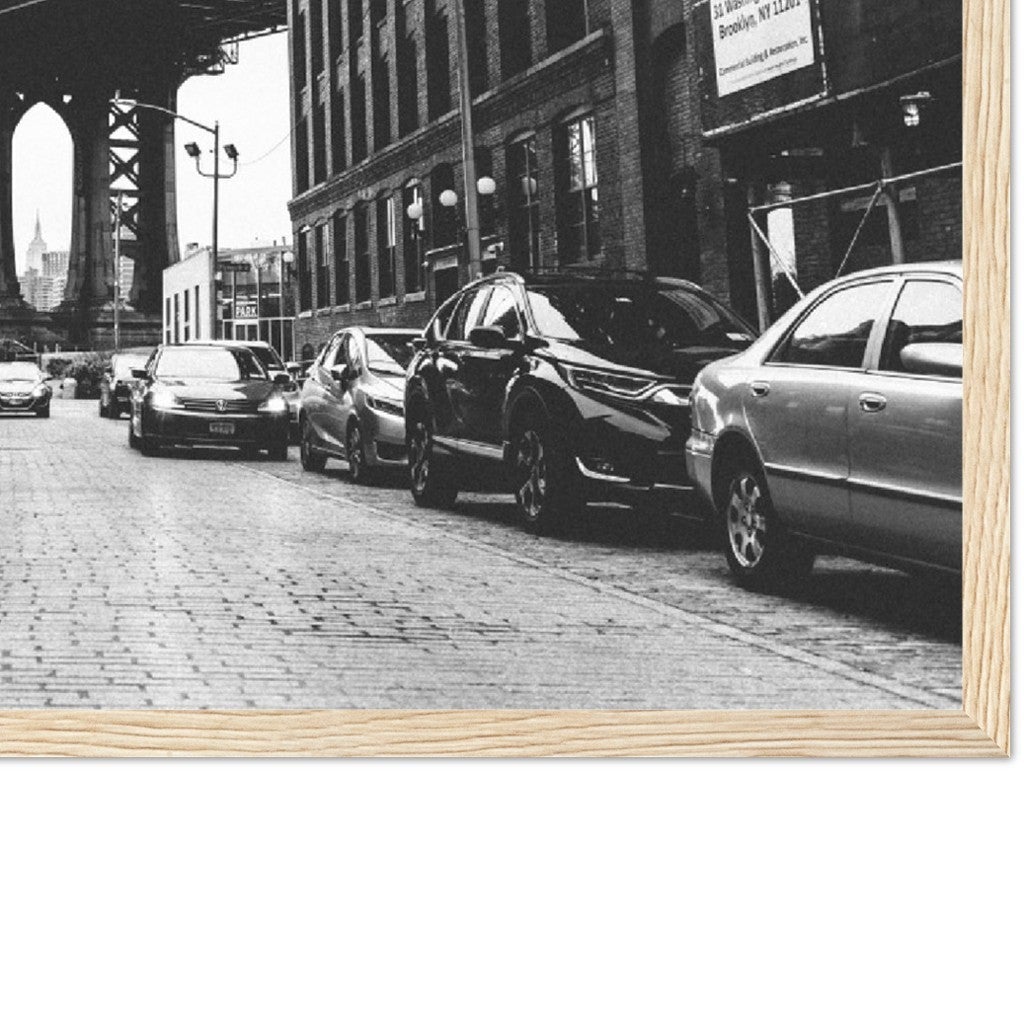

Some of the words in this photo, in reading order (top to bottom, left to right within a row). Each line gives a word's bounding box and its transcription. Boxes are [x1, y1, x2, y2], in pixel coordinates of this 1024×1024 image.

[713, 1, 724, 20] 31
[758, 4, 770, 22] NY
[236, 306, 257, 317] PARK
